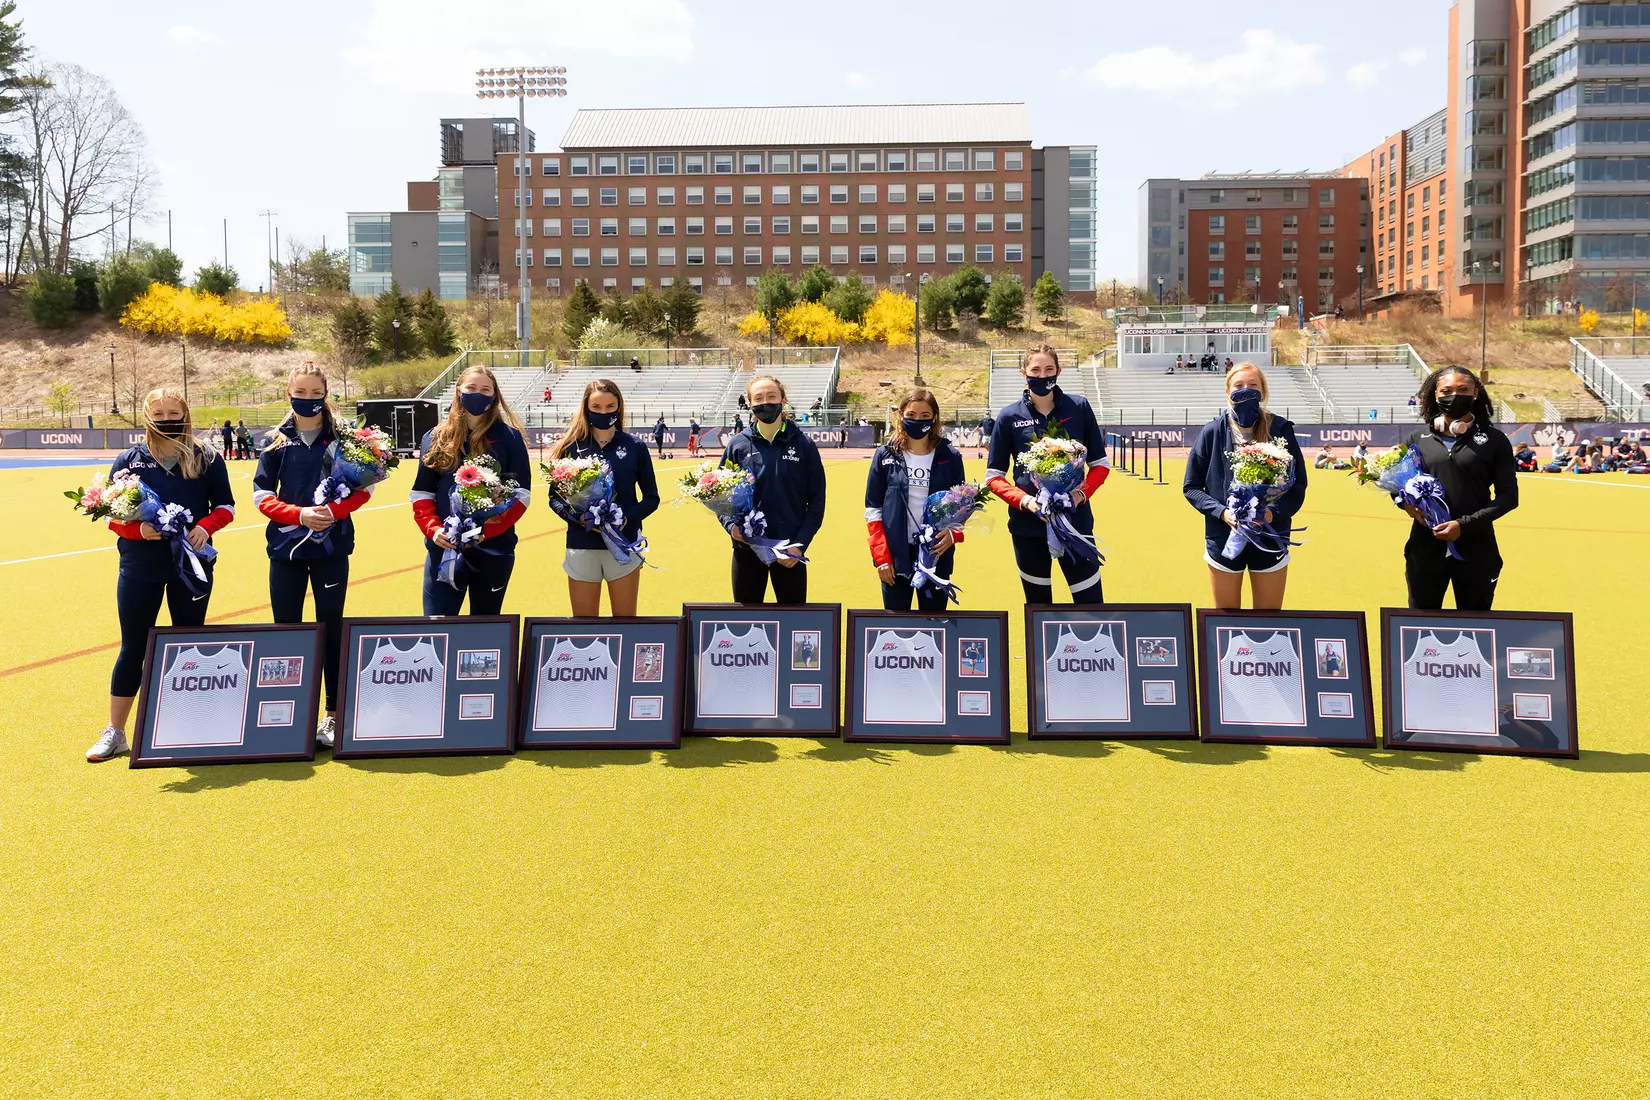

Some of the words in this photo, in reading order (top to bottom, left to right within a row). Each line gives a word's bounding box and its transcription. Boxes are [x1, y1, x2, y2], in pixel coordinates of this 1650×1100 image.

[41, 434, 82, 444] UCONN
[1132, 430, 1182, 442] UCONN
[1320, 430, 1372, 441] UCONN
[711, 652, 768, 667] UCONN
[874, 656, 934, 669] UCONN
[1058, 658, 1115, 672] UCONN
[372, 667, 433, 684] UCONN
[548, 667, 608, 681] UCONN
[1230, 661, 1291, 676] UCONN
[1416, 662, 1481, 678] UCONN
[172, 674, 238, 691] UCONN
